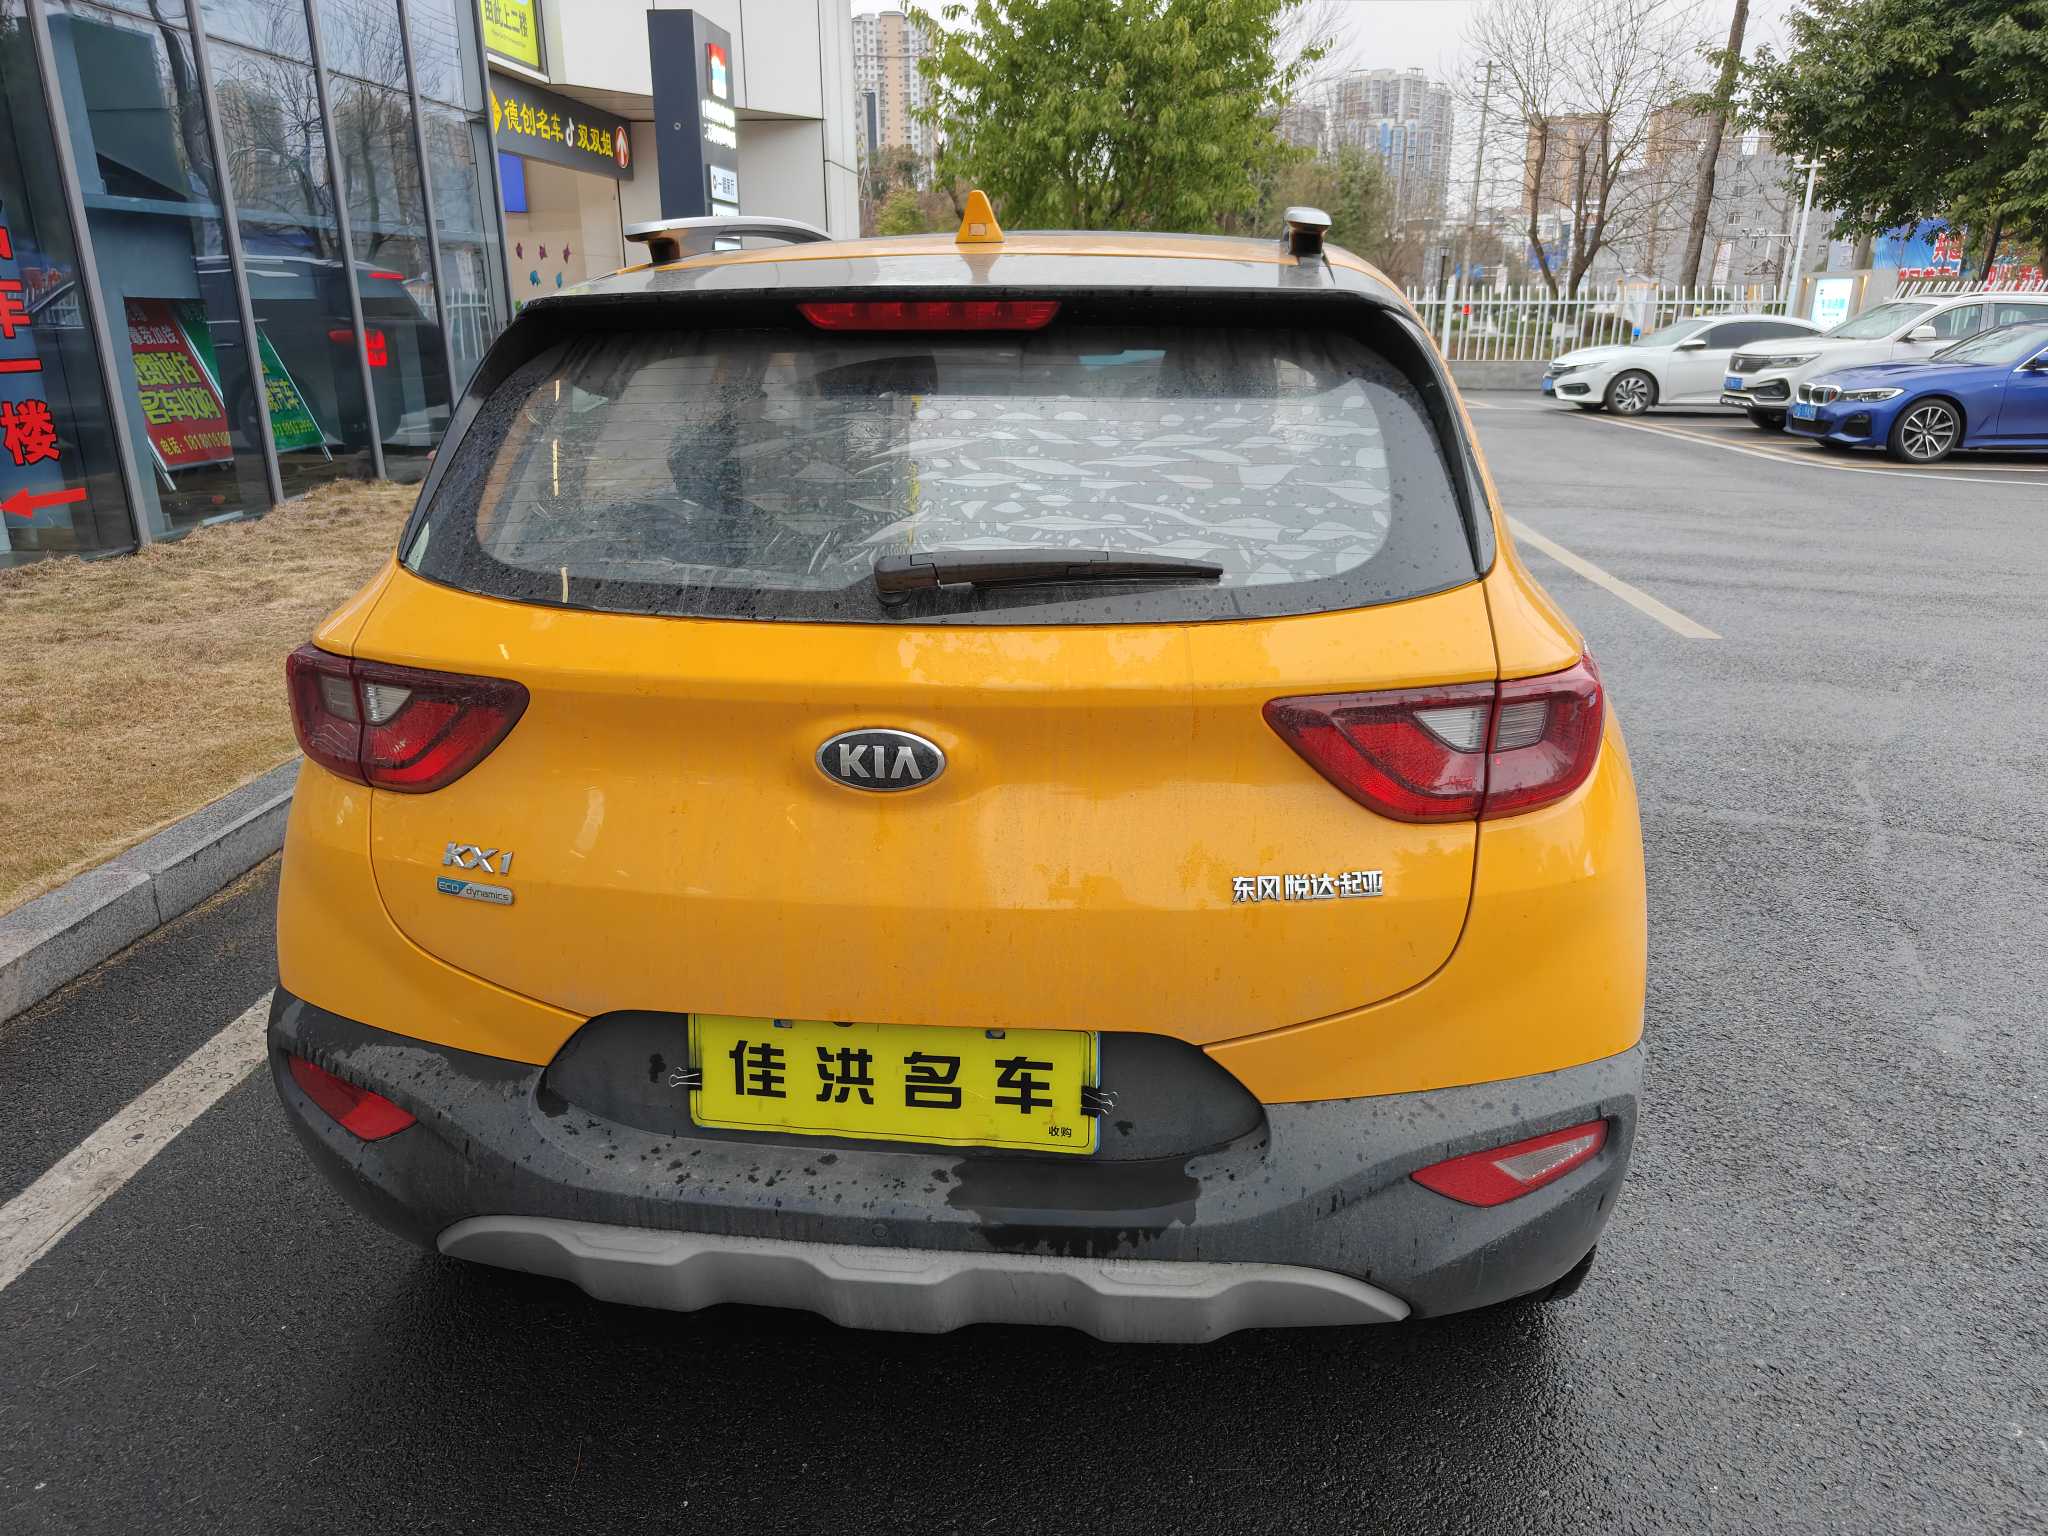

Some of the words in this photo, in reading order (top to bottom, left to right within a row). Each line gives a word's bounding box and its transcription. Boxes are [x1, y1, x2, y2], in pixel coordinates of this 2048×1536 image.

[838, 743, 922, 779] KIA
[442, 841, 513, 876] KX1
[466, 885, 509, 902] dynamics
[728, 1040, 1054, 1114] 佳洪名车
[1047, 1124, 1072, 1138] 收购
